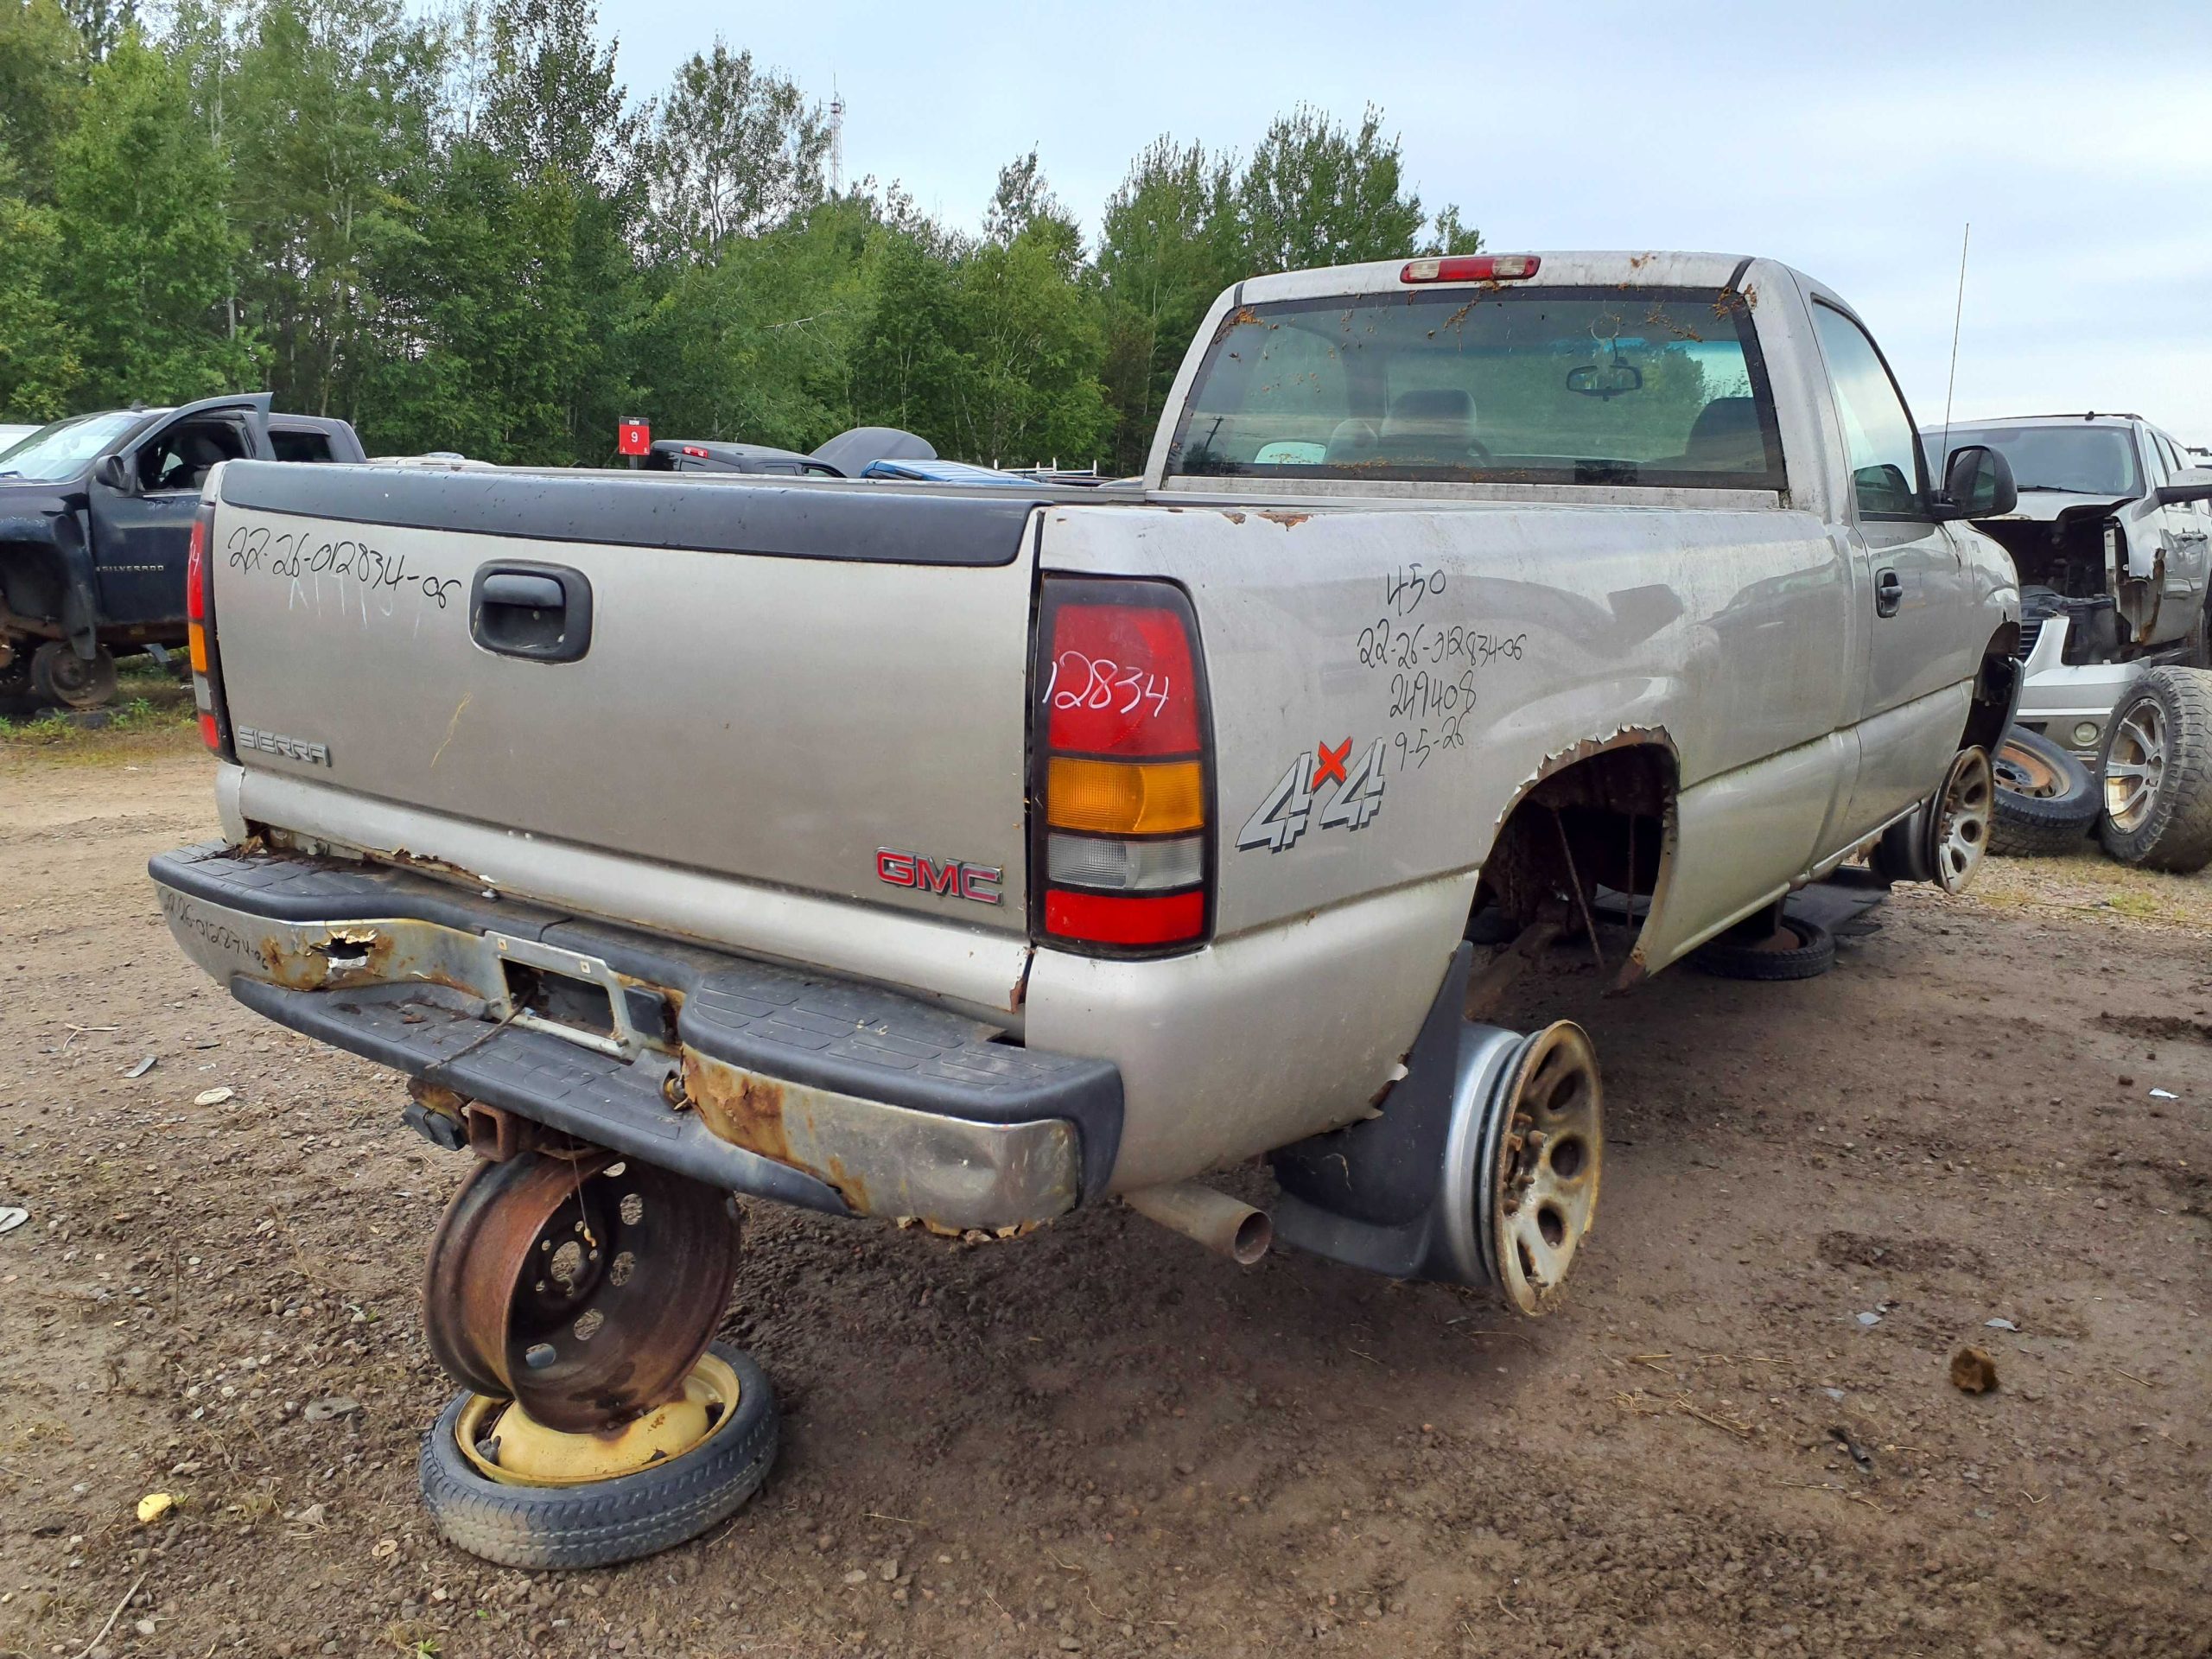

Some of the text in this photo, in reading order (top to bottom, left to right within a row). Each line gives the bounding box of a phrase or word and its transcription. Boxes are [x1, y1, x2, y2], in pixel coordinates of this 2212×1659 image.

[631, 430, 639, 443] 9
[1387, 563, 1446, 617] 450
[1042, 651, 1169, 717] 12834
[238, 725, 333, 768] SIERRA
[874, 845, 1003, 906] GMC
